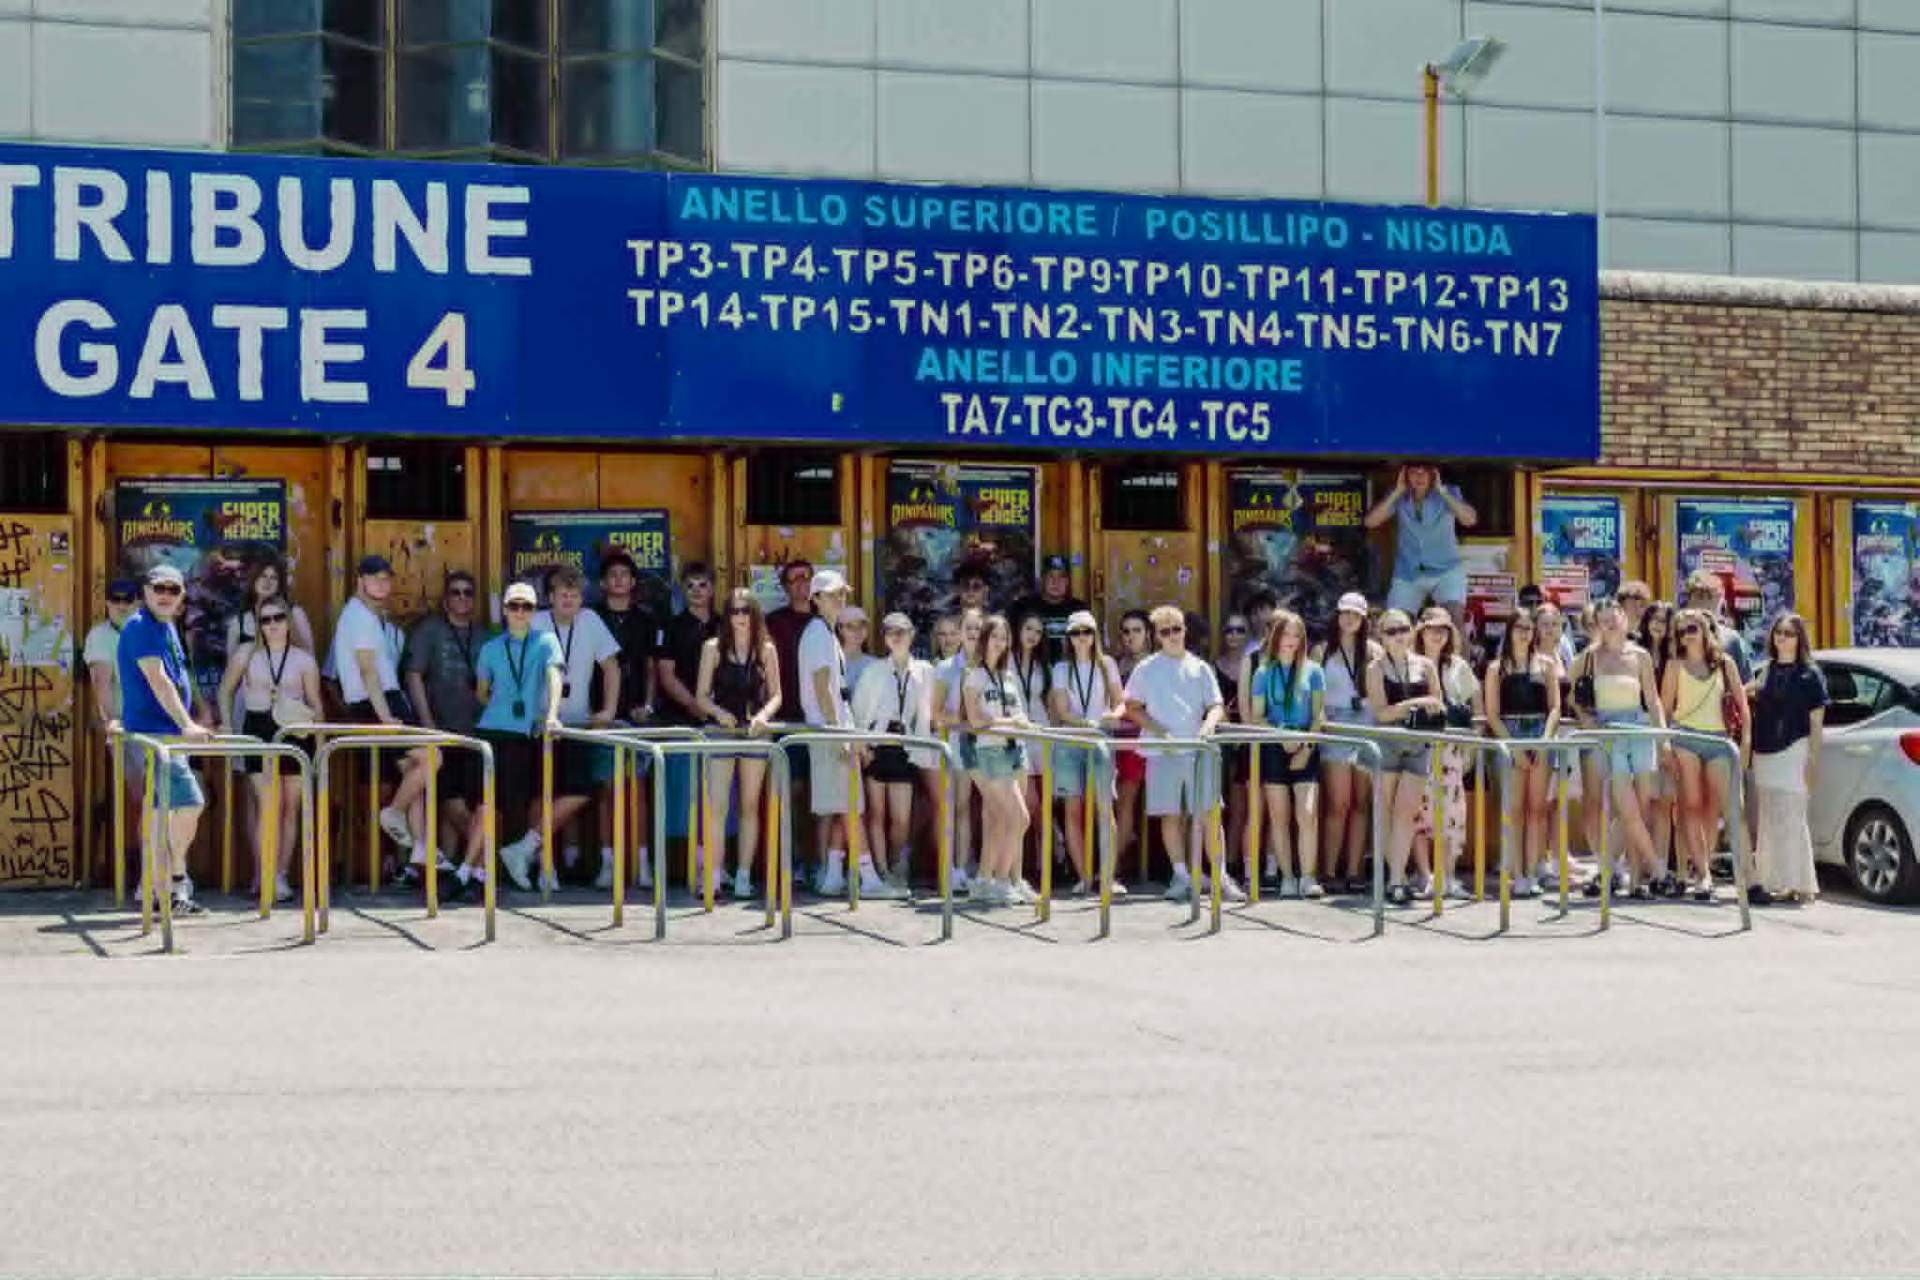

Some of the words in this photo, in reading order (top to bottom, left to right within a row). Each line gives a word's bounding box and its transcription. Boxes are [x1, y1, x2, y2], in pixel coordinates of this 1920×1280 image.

[0, 163, 533, 276] TRIBUNE
[679, 186, 848, 226] ANELLO
[864, 195, 1098, 236] SUPERIORE
[1145, 207, 1350, 249] POSILLIPO
[1384, 218, 1512, 256] NISIDA
[34, 300, 369, 403] GATE
[406, 311, 476, 408] 4
[916, 347, 1078, 385] ANELLO
[1092, 351, 1303, 392] INFERIORE
